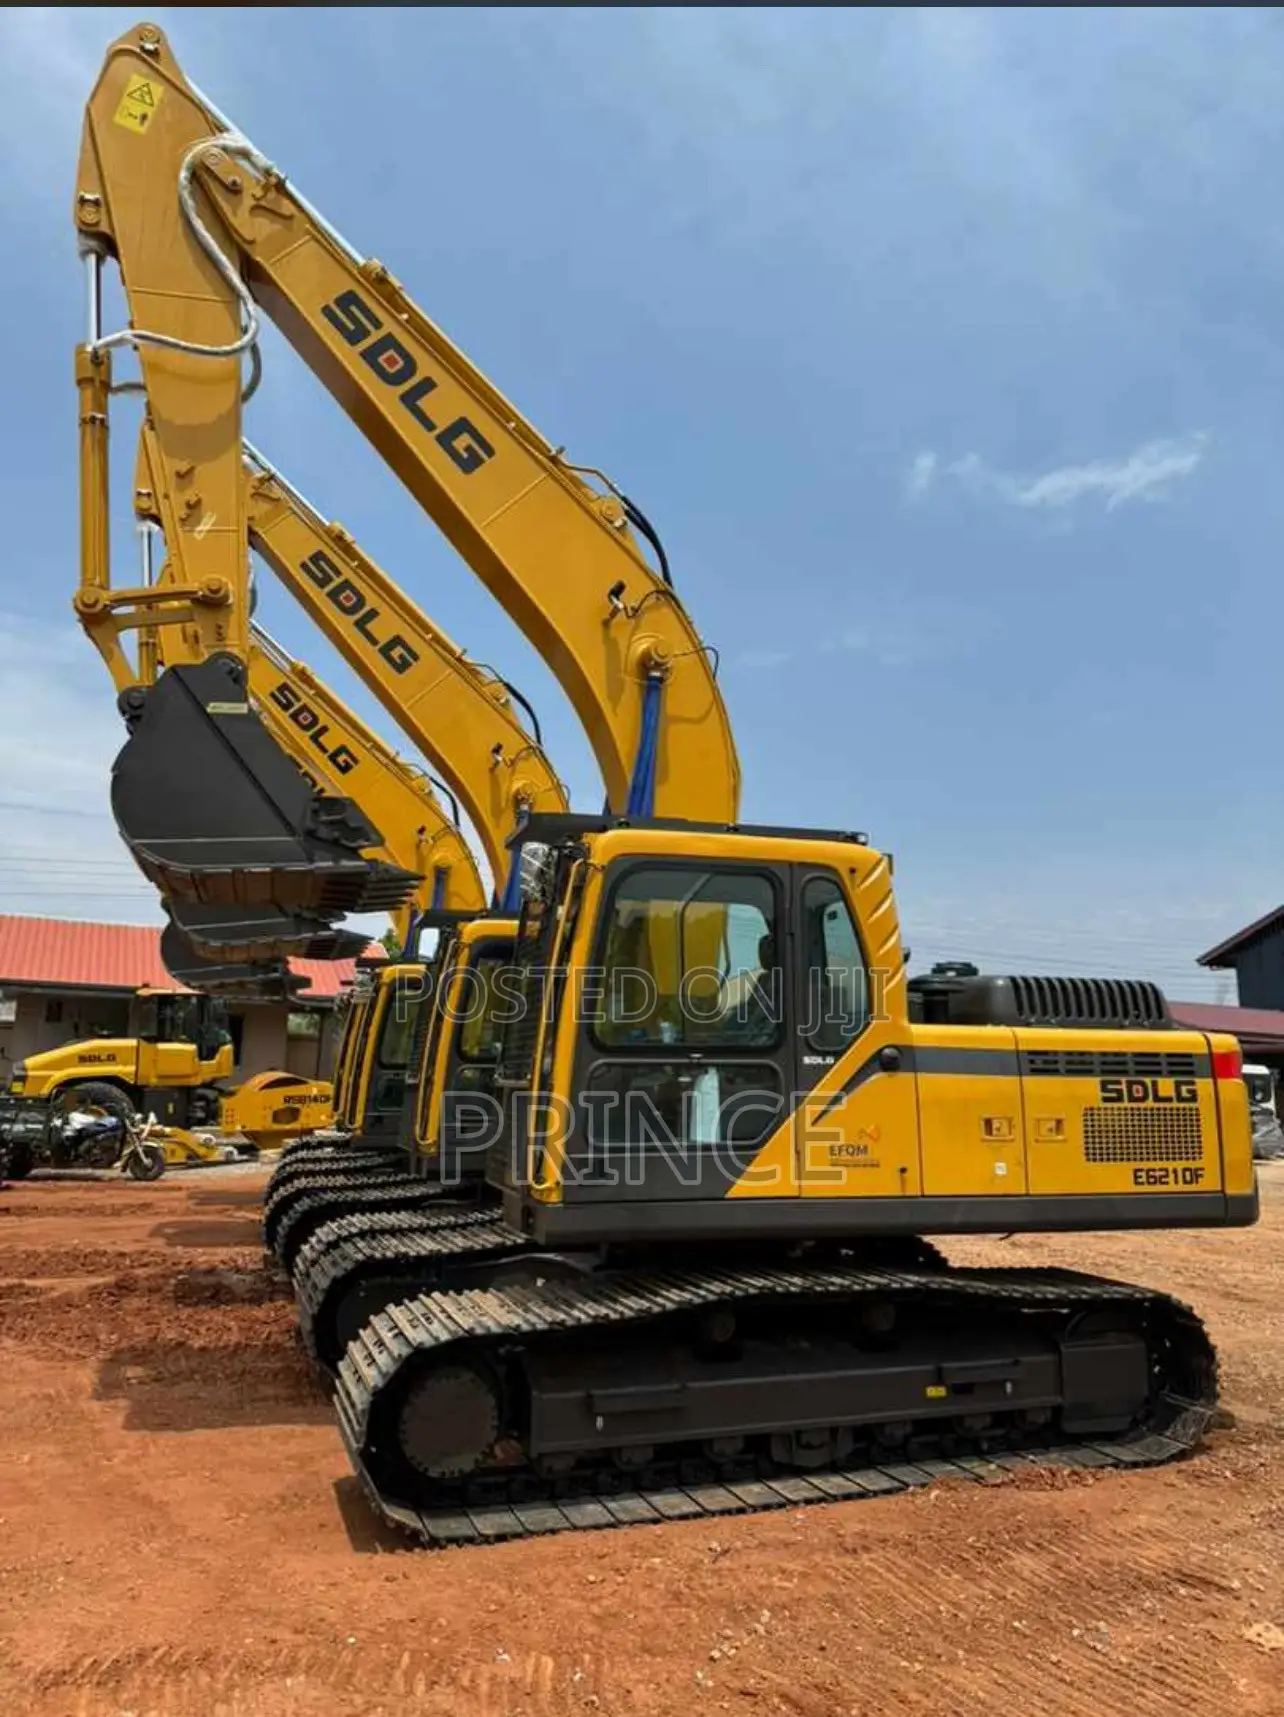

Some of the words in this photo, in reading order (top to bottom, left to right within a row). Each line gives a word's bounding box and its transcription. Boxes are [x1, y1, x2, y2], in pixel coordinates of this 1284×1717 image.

[321, 289, 495, 475] SDLG
[300, 550, 420, 674] SDLG
[269, 682, 360, 776] SDLG
[77, 1053, 117, 1064] SDLG
[803, 1055, 835, 1065] SDLG
[1100, 1078, 1199, 1103] SDLG
[829, 1144, 869, 1157] EFQM
[1133, 1167, 1205, 1186] E6210F
